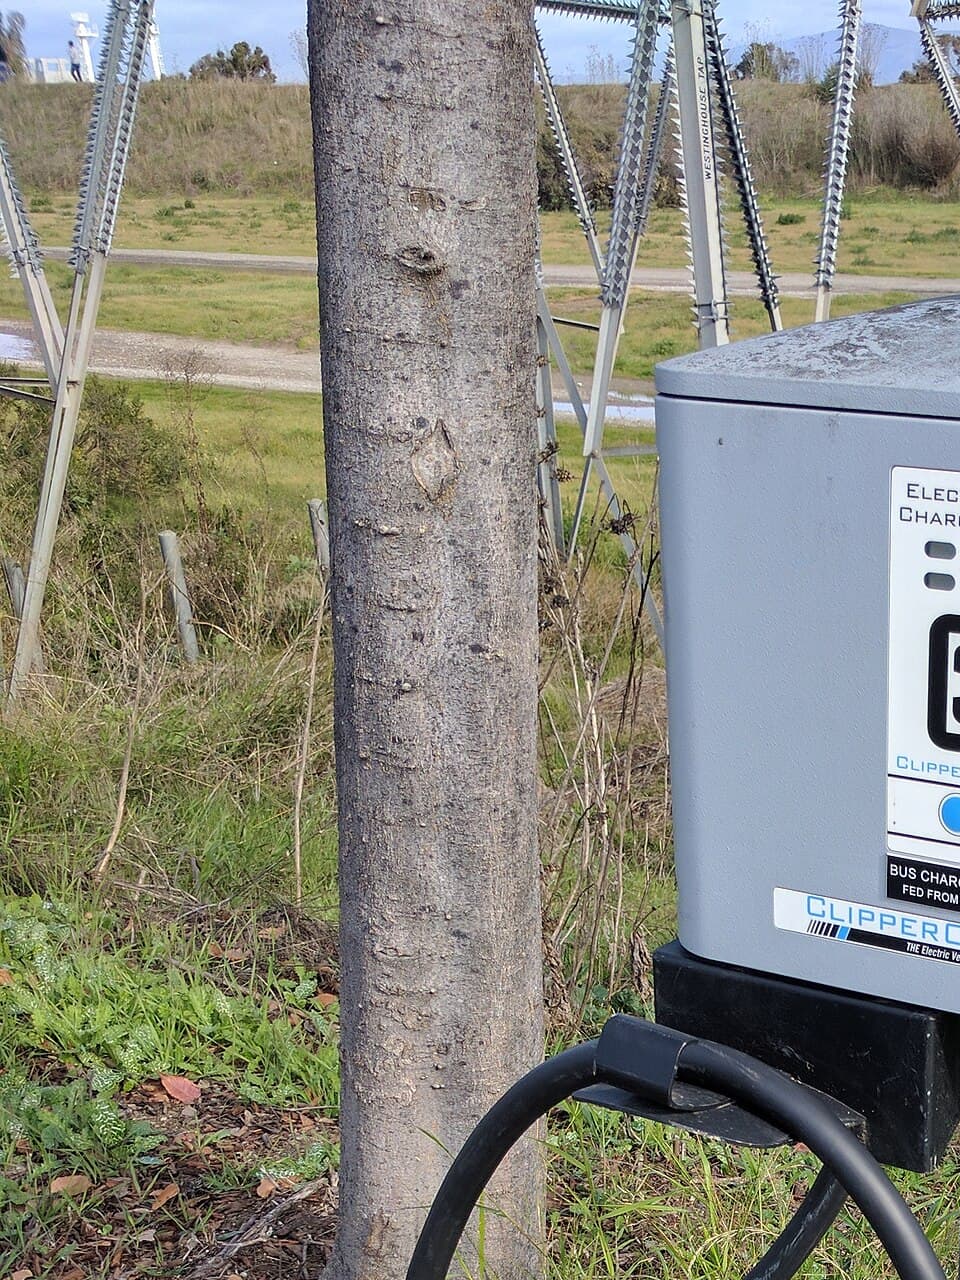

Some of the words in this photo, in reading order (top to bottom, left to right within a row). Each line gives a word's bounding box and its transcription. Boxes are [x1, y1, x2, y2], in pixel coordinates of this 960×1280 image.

[696, 56, 706, 80] TAP
[699, 88, 712, 180] WESTINGHOUSE
[889, 863, 918, 881] BUS
[902, 883, 925, 899] FED
[926, 888, 960, 906] FROM
[906, 941, 921, 953] THE
[921, 944, 950, 960] Electric
